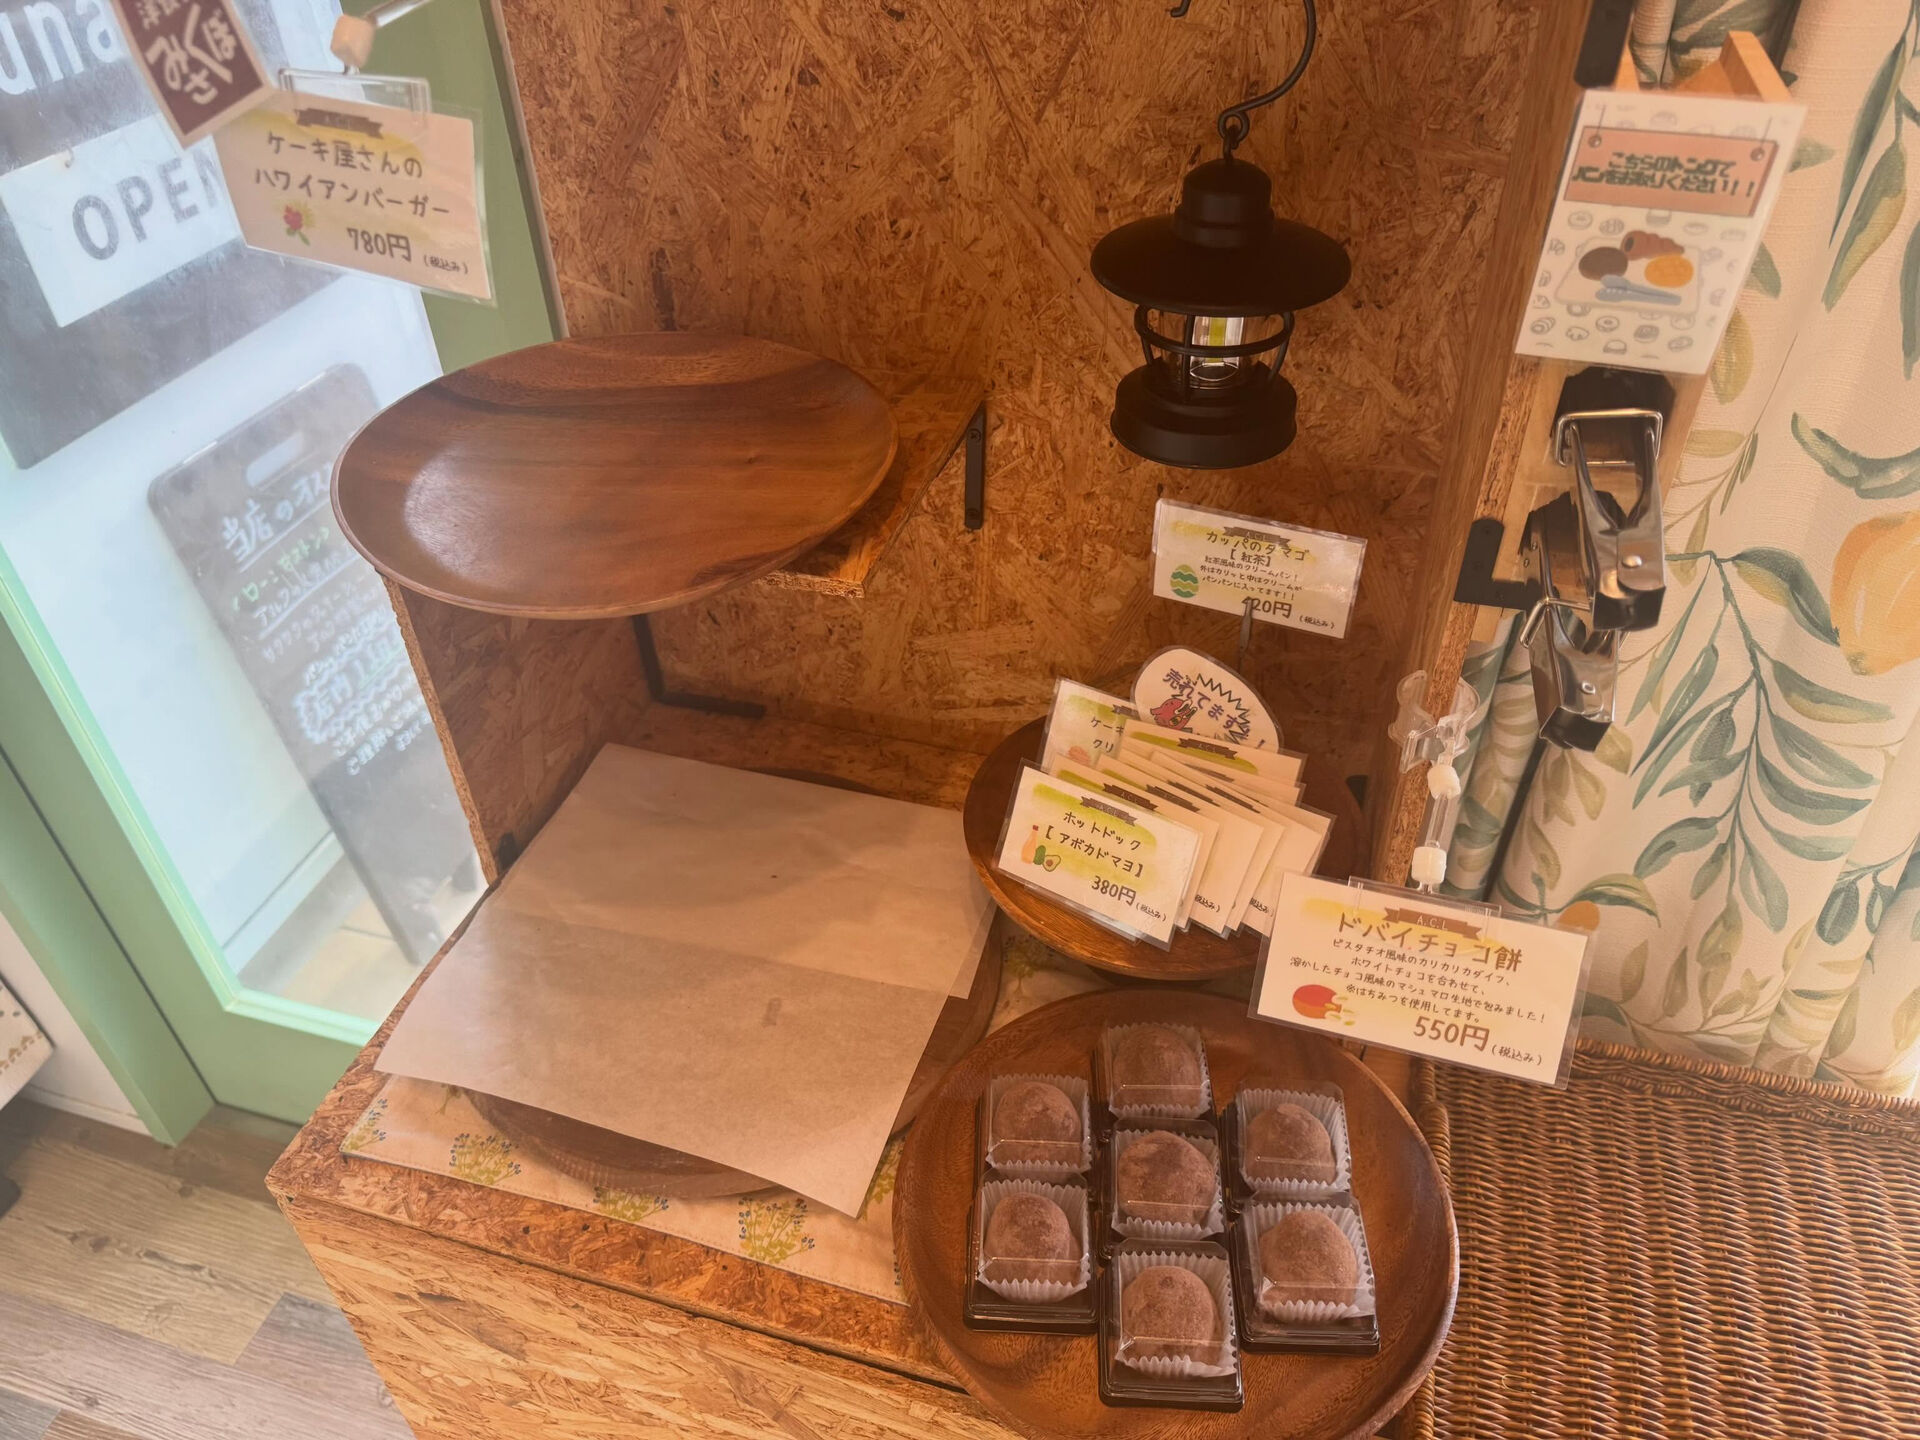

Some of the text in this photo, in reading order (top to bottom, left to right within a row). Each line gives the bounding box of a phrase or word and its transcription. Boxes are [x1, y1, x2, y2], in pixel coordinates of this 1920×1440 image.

[267, 131, 424, 179] ケーキ屋さんの
[255, 168, 450, 218] ハワイアンバーガー
[346, 227, 413, 263] 780円
[1206, 531, 1309, 561] カッパのタマゴ
[1231, 549, 1271, 567] 【紅茶】
[1063, 811, 1141, 851] ホットドック
[1045, 825, 1144, 878] 【アボカドマヨ】
[1091, 875, 1137, 907] 380円
[1338, 911, 1523, 973] ドバイチョコ餅
[1332, 938, 1511, 987] ピスタチオ風味のカリカリカダイフ、
[1351, 957, 1485, 996] ホワイトチョコを合わせて、
[1289, 956, 1546, 1024] 溶かしたチョコ風味のマシュマロ生地で包みました！
[1345, 983, 1480, 1024] ※はちみつを使用してます。
[1413, 1015, 1491, 1053] 550円
